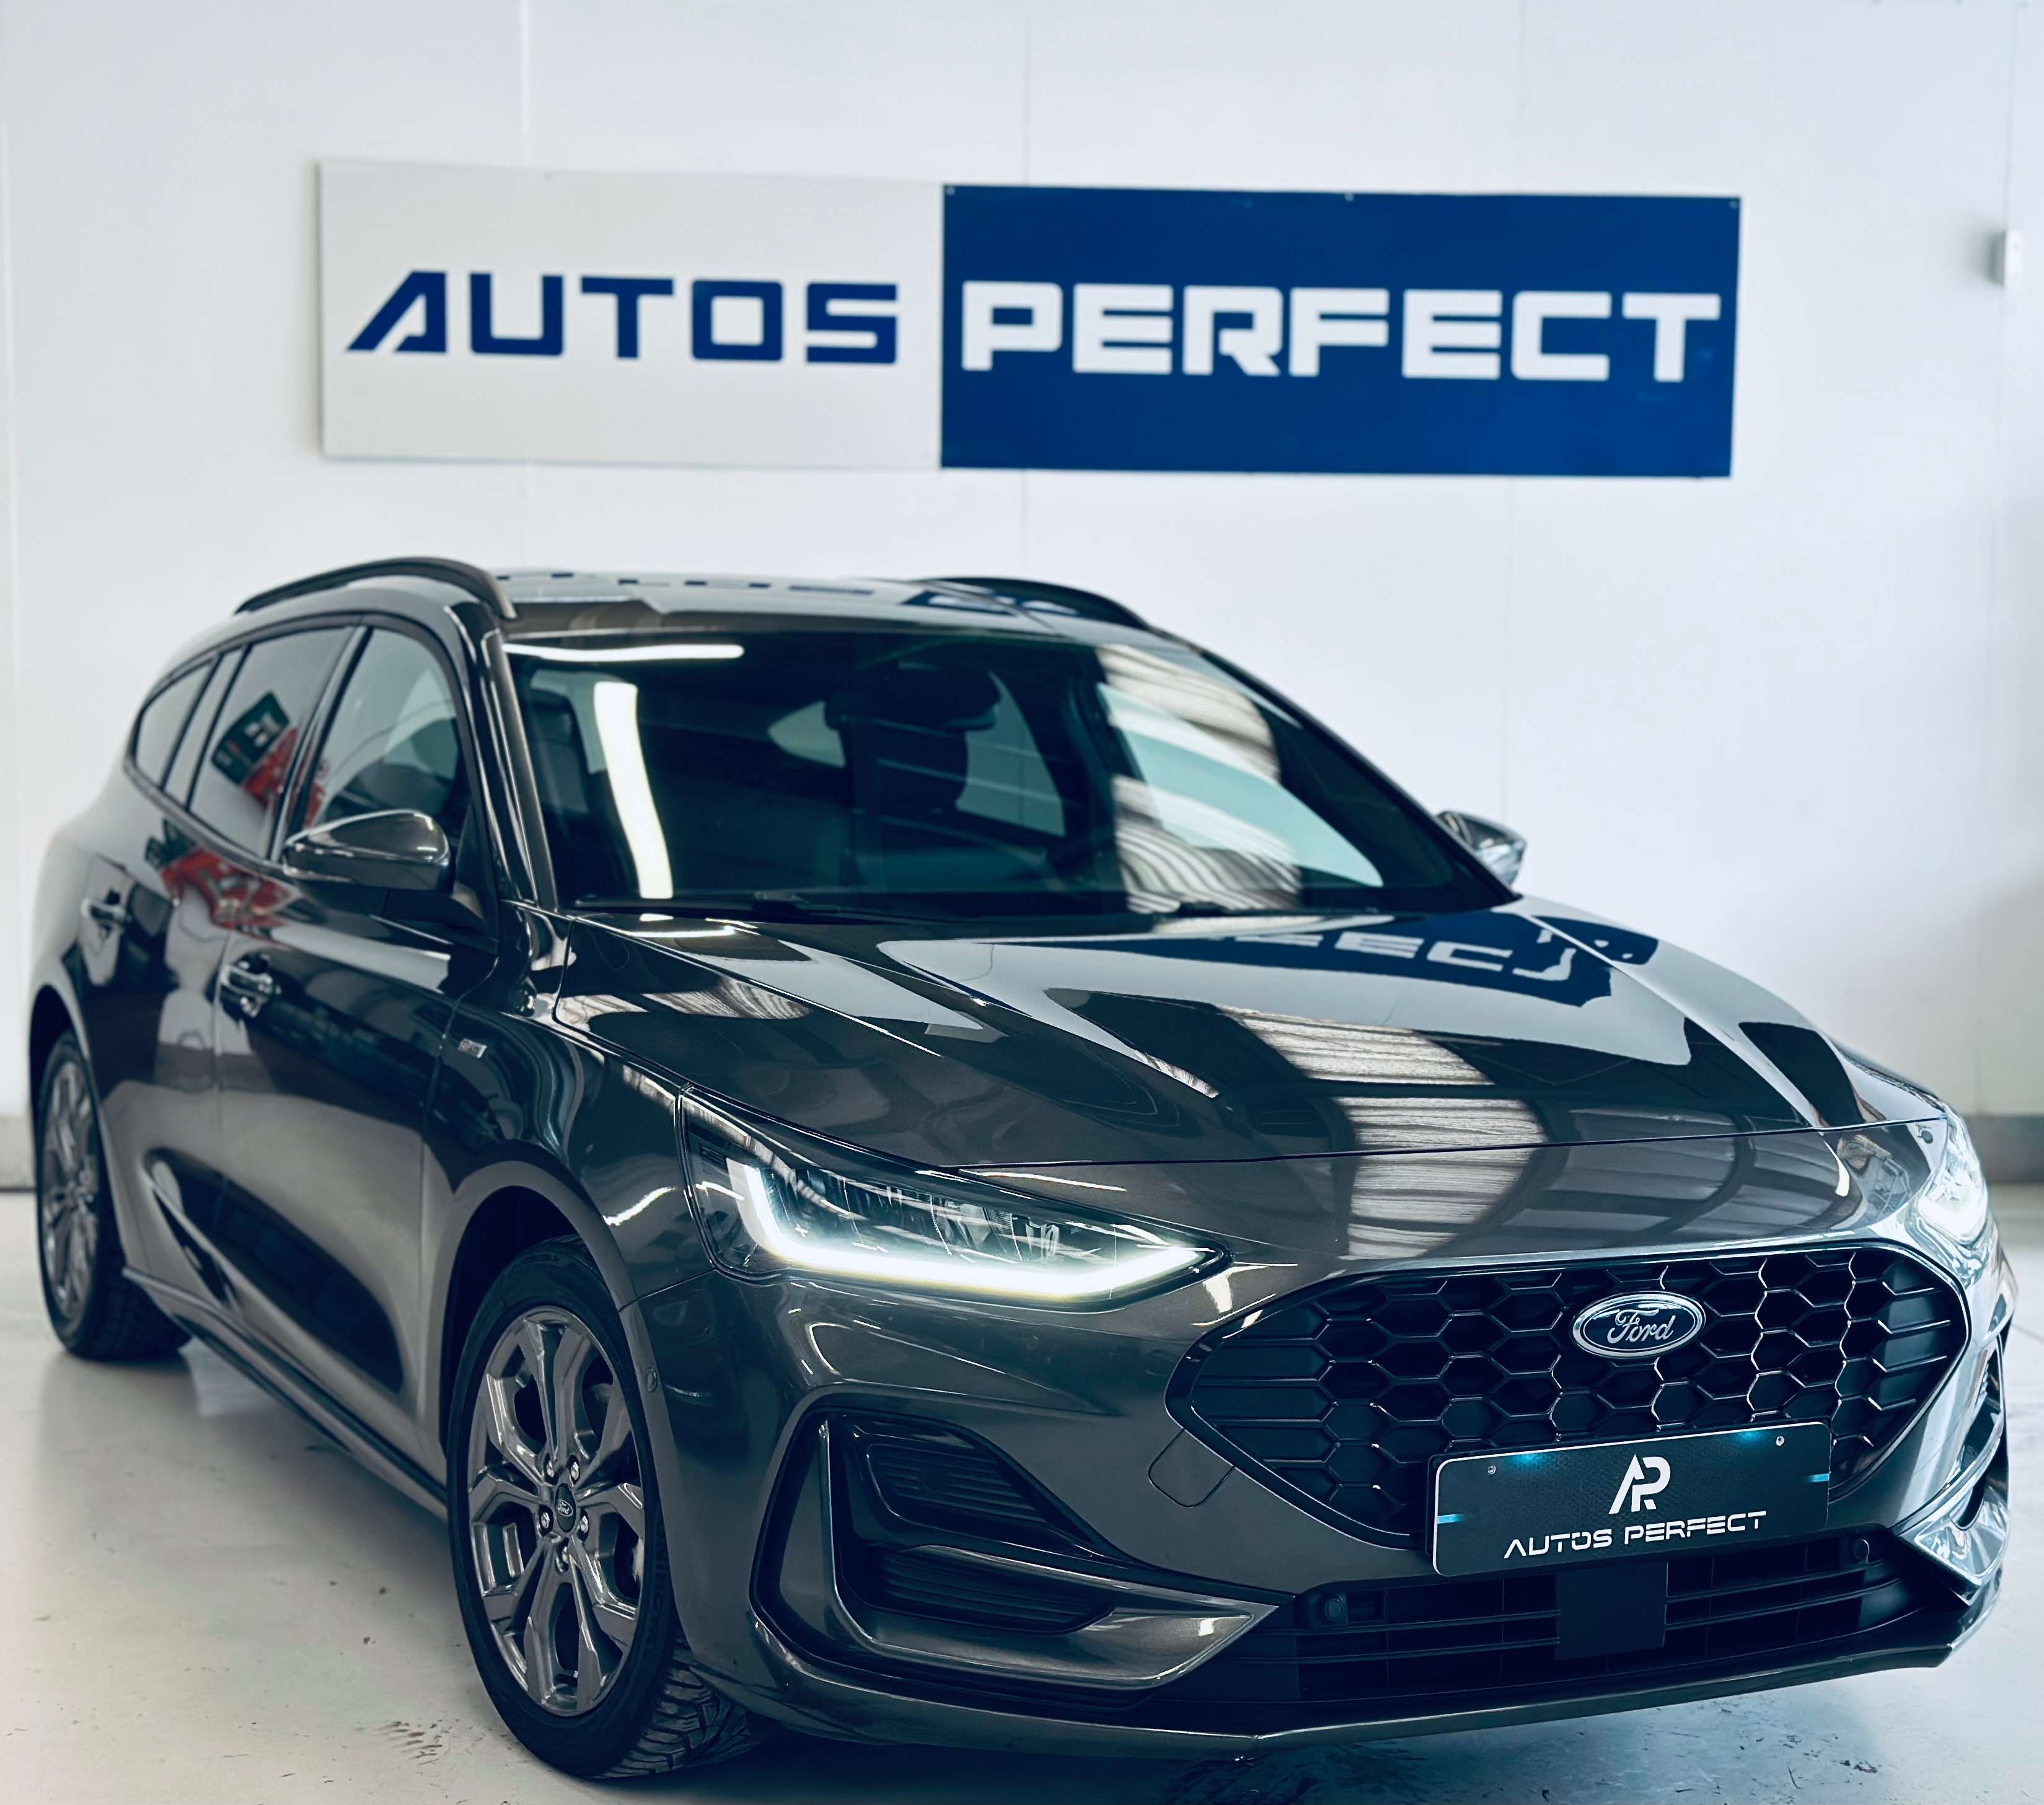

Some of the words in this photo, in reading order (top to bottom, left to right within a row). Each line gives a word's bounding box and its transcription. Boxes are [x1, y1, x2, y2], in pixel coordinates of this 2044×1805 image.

[347, 270, 898, 365] AUTOS
[961, 281, 1722, 383] PERFECT
[1607, 1309, 1676, 1343] Ford
[1504, 1529, 1613, 1559] AUTOS
[1624, 1510, 1767, 1545] PERFECT
